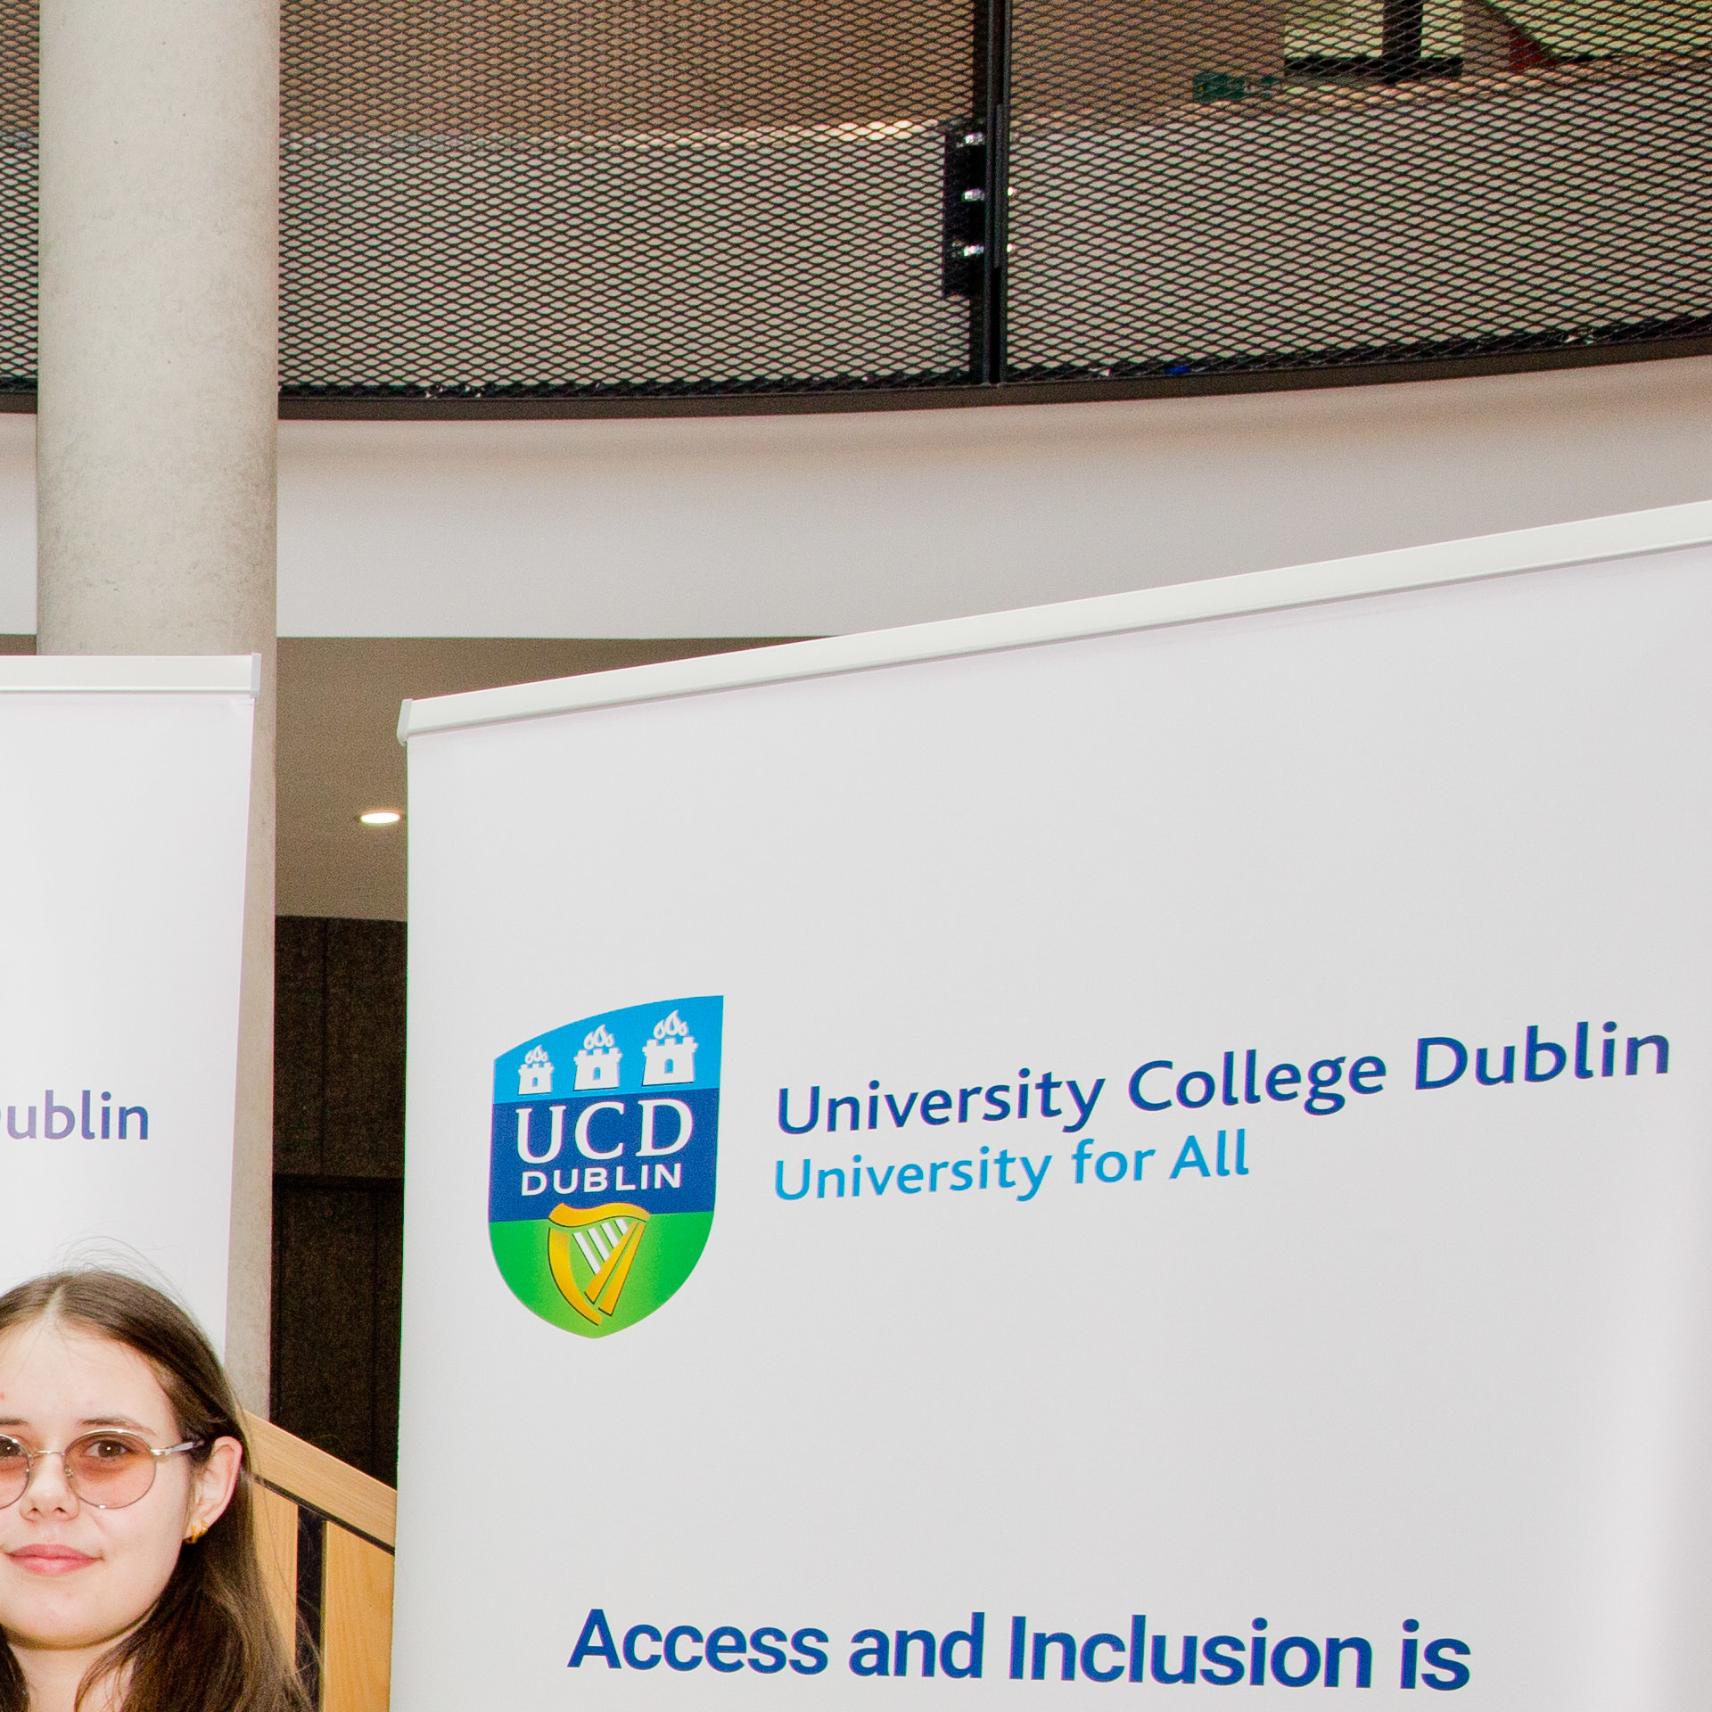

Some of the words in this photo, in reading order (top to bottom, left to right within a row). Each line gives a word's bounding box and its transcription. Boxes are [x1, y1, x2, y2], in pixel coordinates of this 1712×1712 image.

[779, 1068, 1105, 1134] University
[1129, 1049, 1386, 1115] College
[1416, 1021, 1669, 1090] Dublin
[514, 1096, 695, 1167] UCD
[776, 1146, 1051, 1201] University
[1072, 1140, 1155, 1184] for
[1171, 1129, 1249, 1179] All
[520, 1161, 683, 1197] DUBLIN
[568, 1609, 829, 1675] Access
[849, 1612, 985, 1678] and
[1010, 1615, 1373, 1688] Inclusion
[1401, 1619, 1470, 1691] is
